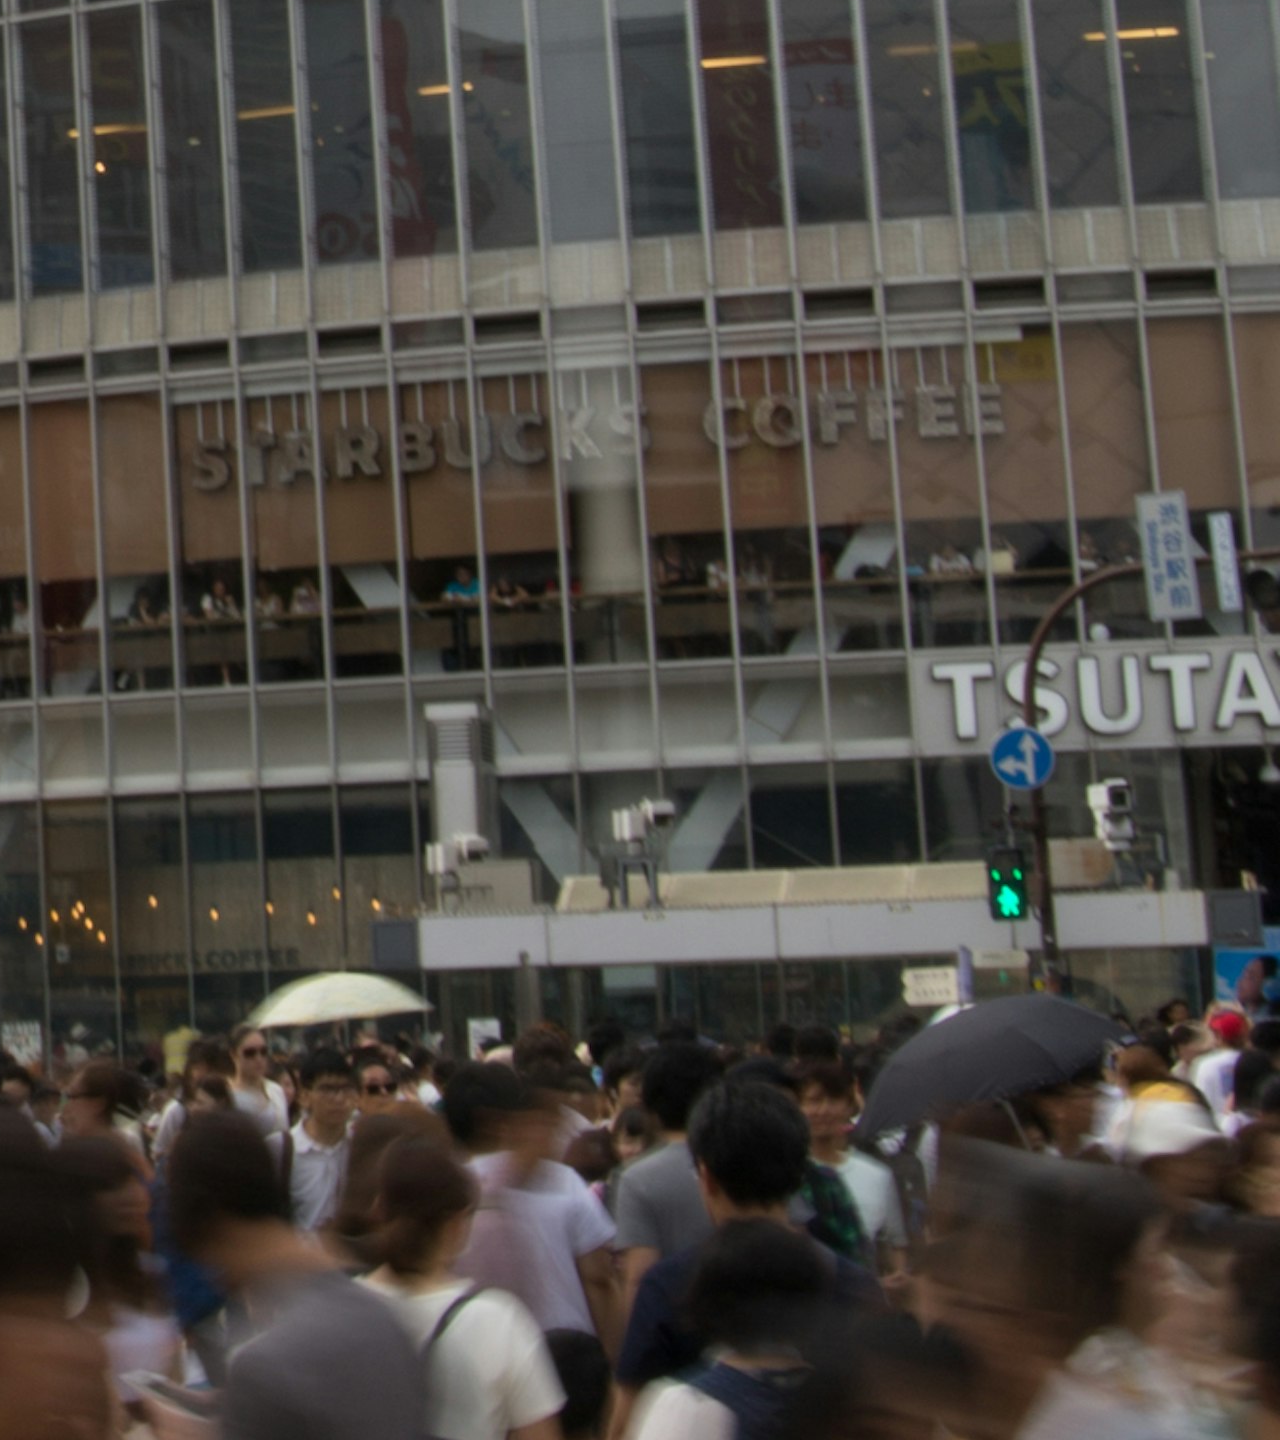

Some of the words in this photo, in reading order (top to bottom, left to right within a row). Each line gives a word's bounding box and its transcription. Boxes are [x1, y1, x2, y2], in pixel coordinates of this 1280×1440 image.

[193, 402, 650, 494] STARBUCKS
[703, 382, 1006, 450] COFFEE
[931, 650, 1280, 743] TSUTA
